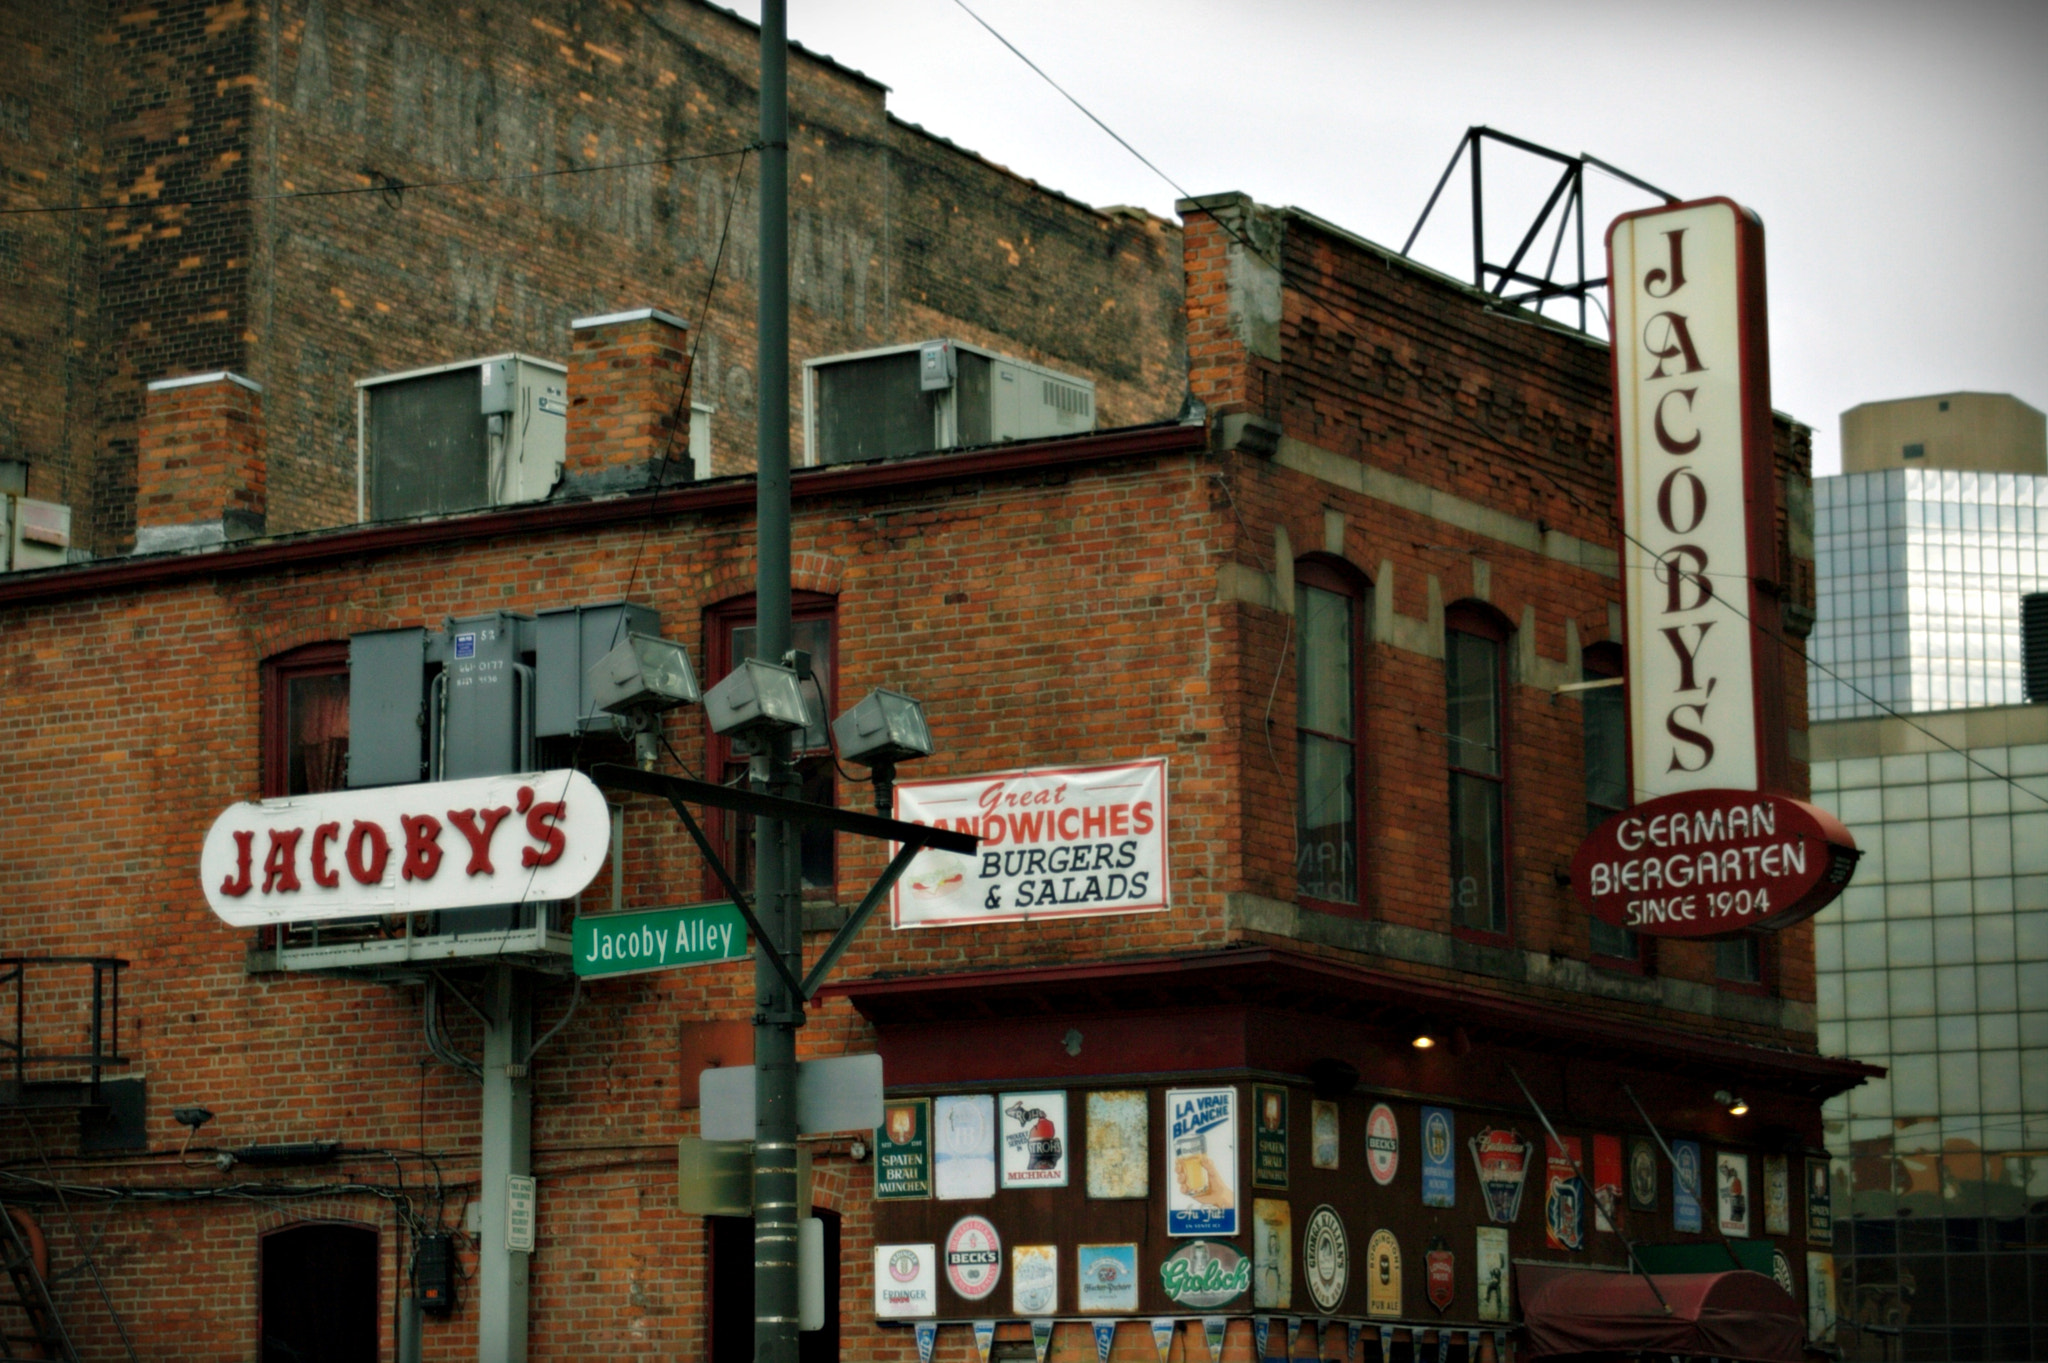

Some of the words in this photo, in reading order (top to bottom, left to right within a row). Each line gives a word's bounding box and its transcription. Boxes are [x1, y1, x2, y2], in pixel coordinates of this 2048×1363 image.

[664, 160, 876, 332] COMANY
[1642, 226, 1718, 776] JACOBY'S
[977, 781, 1068, 821] Great
[219, 785, 568, 899] JACOBY'S
[908, 800, 1155, 853] NDWICHES
[1616, 802, 1776, 851] GERMAN
[978, 840, 1138, 879] BURGERS
[1590, 842, 1806, 896] BIERGARTEN
[984, 884, 1001, 910] &
[1014, 871, 1150, 908] SALADS
[1626, 894, 1697, 926] SINCE
[1705, 887, 1770, 918] 1904
[585, 924, 670, 966] Jacoby
[674, 919, 734, 957] Alley
[1172, 1104, 1230, 1140] BLANCHE
[1175, 1099, 1195, 1120] LA
[1196, 1094, 1230, 1111] VRAIE
[881, 1153, 923, 1167] SPATEN
[1368, 1137, 1396, 1151] BECK'S
[1007, 1170, 1062, 1180] MICHIGAN
[951, 1251, 997, 1264] BECK'S
[1308, 1223, 1321, 1269] GEORGE
[1321, 1213, 1345, 1270] KILLIAN'S
[882, 1289, 928, 1301] ERDINGER
[1161, 1256, 1251, 1301] Grolsch
[1371, 1300, 1386, 1311] PUB
[1387, 1300, 1400, 1312] ALE
